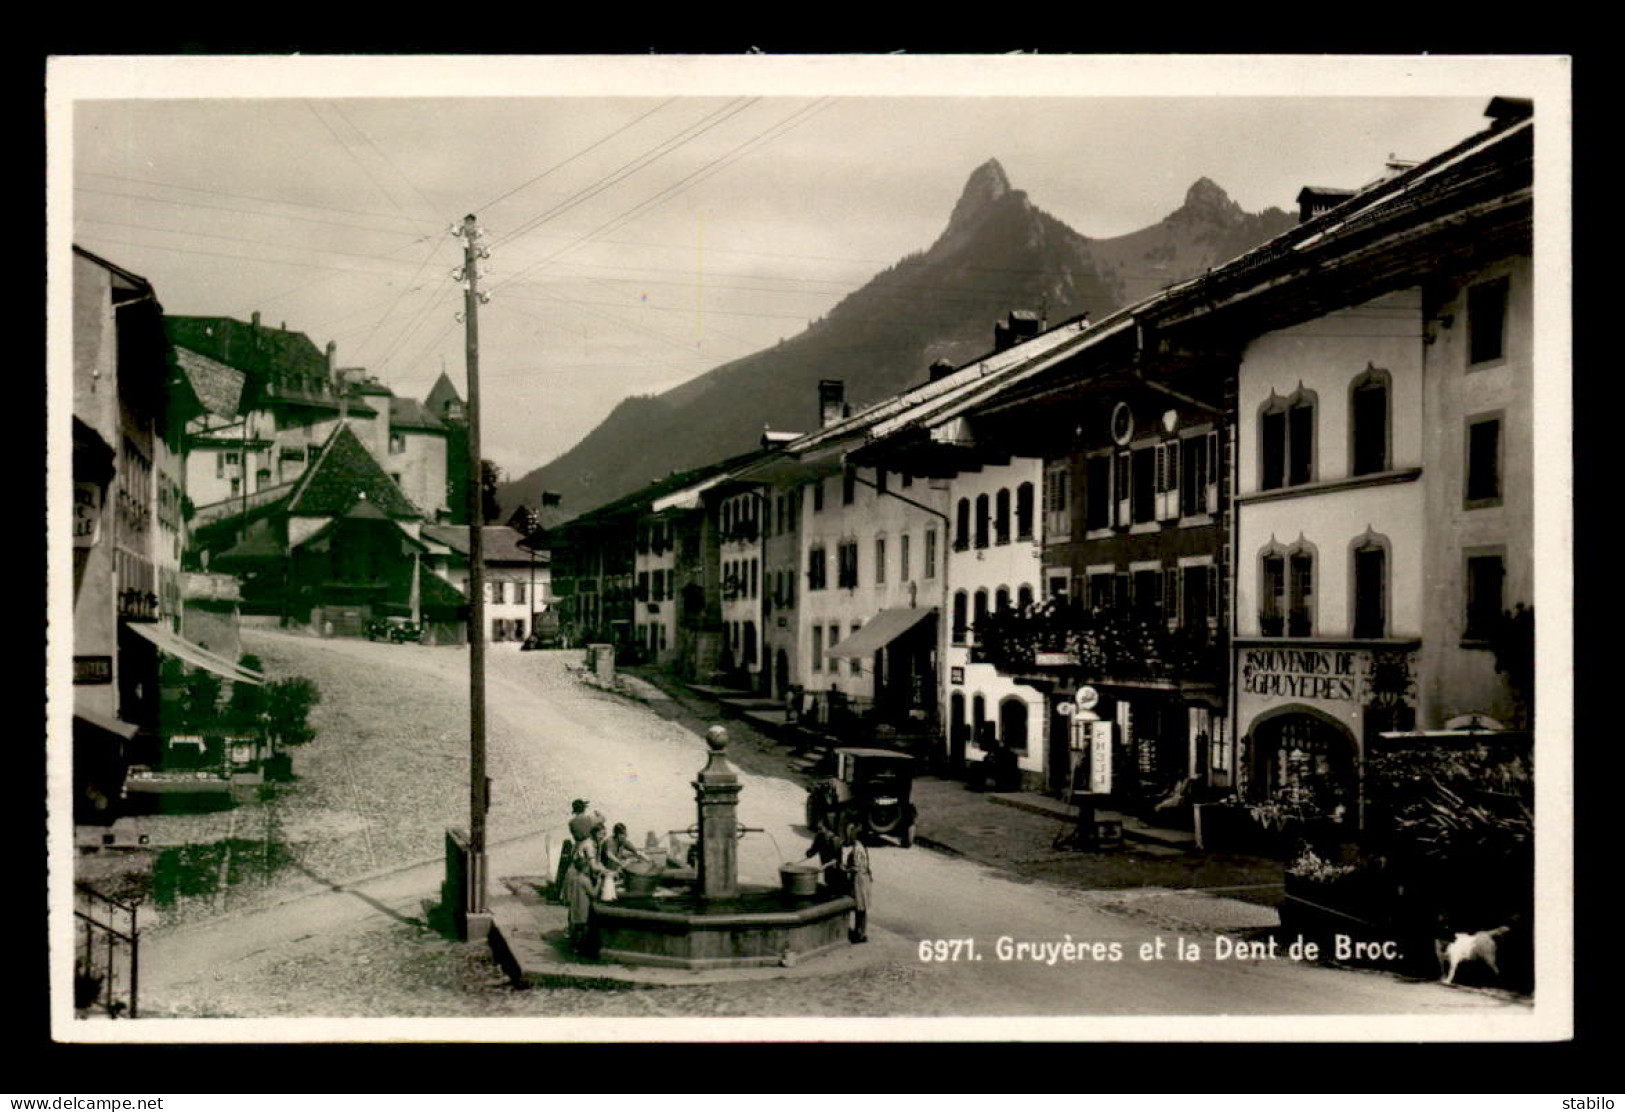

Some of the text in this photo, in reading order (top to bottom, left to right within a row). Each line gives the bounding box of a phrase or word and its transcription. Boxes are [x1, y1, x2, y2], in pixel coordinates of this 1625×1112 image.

[1248, 650, 1356, 675] SOUVENIRS DE
[1253, 673, 1354, 702] GRUYERES
